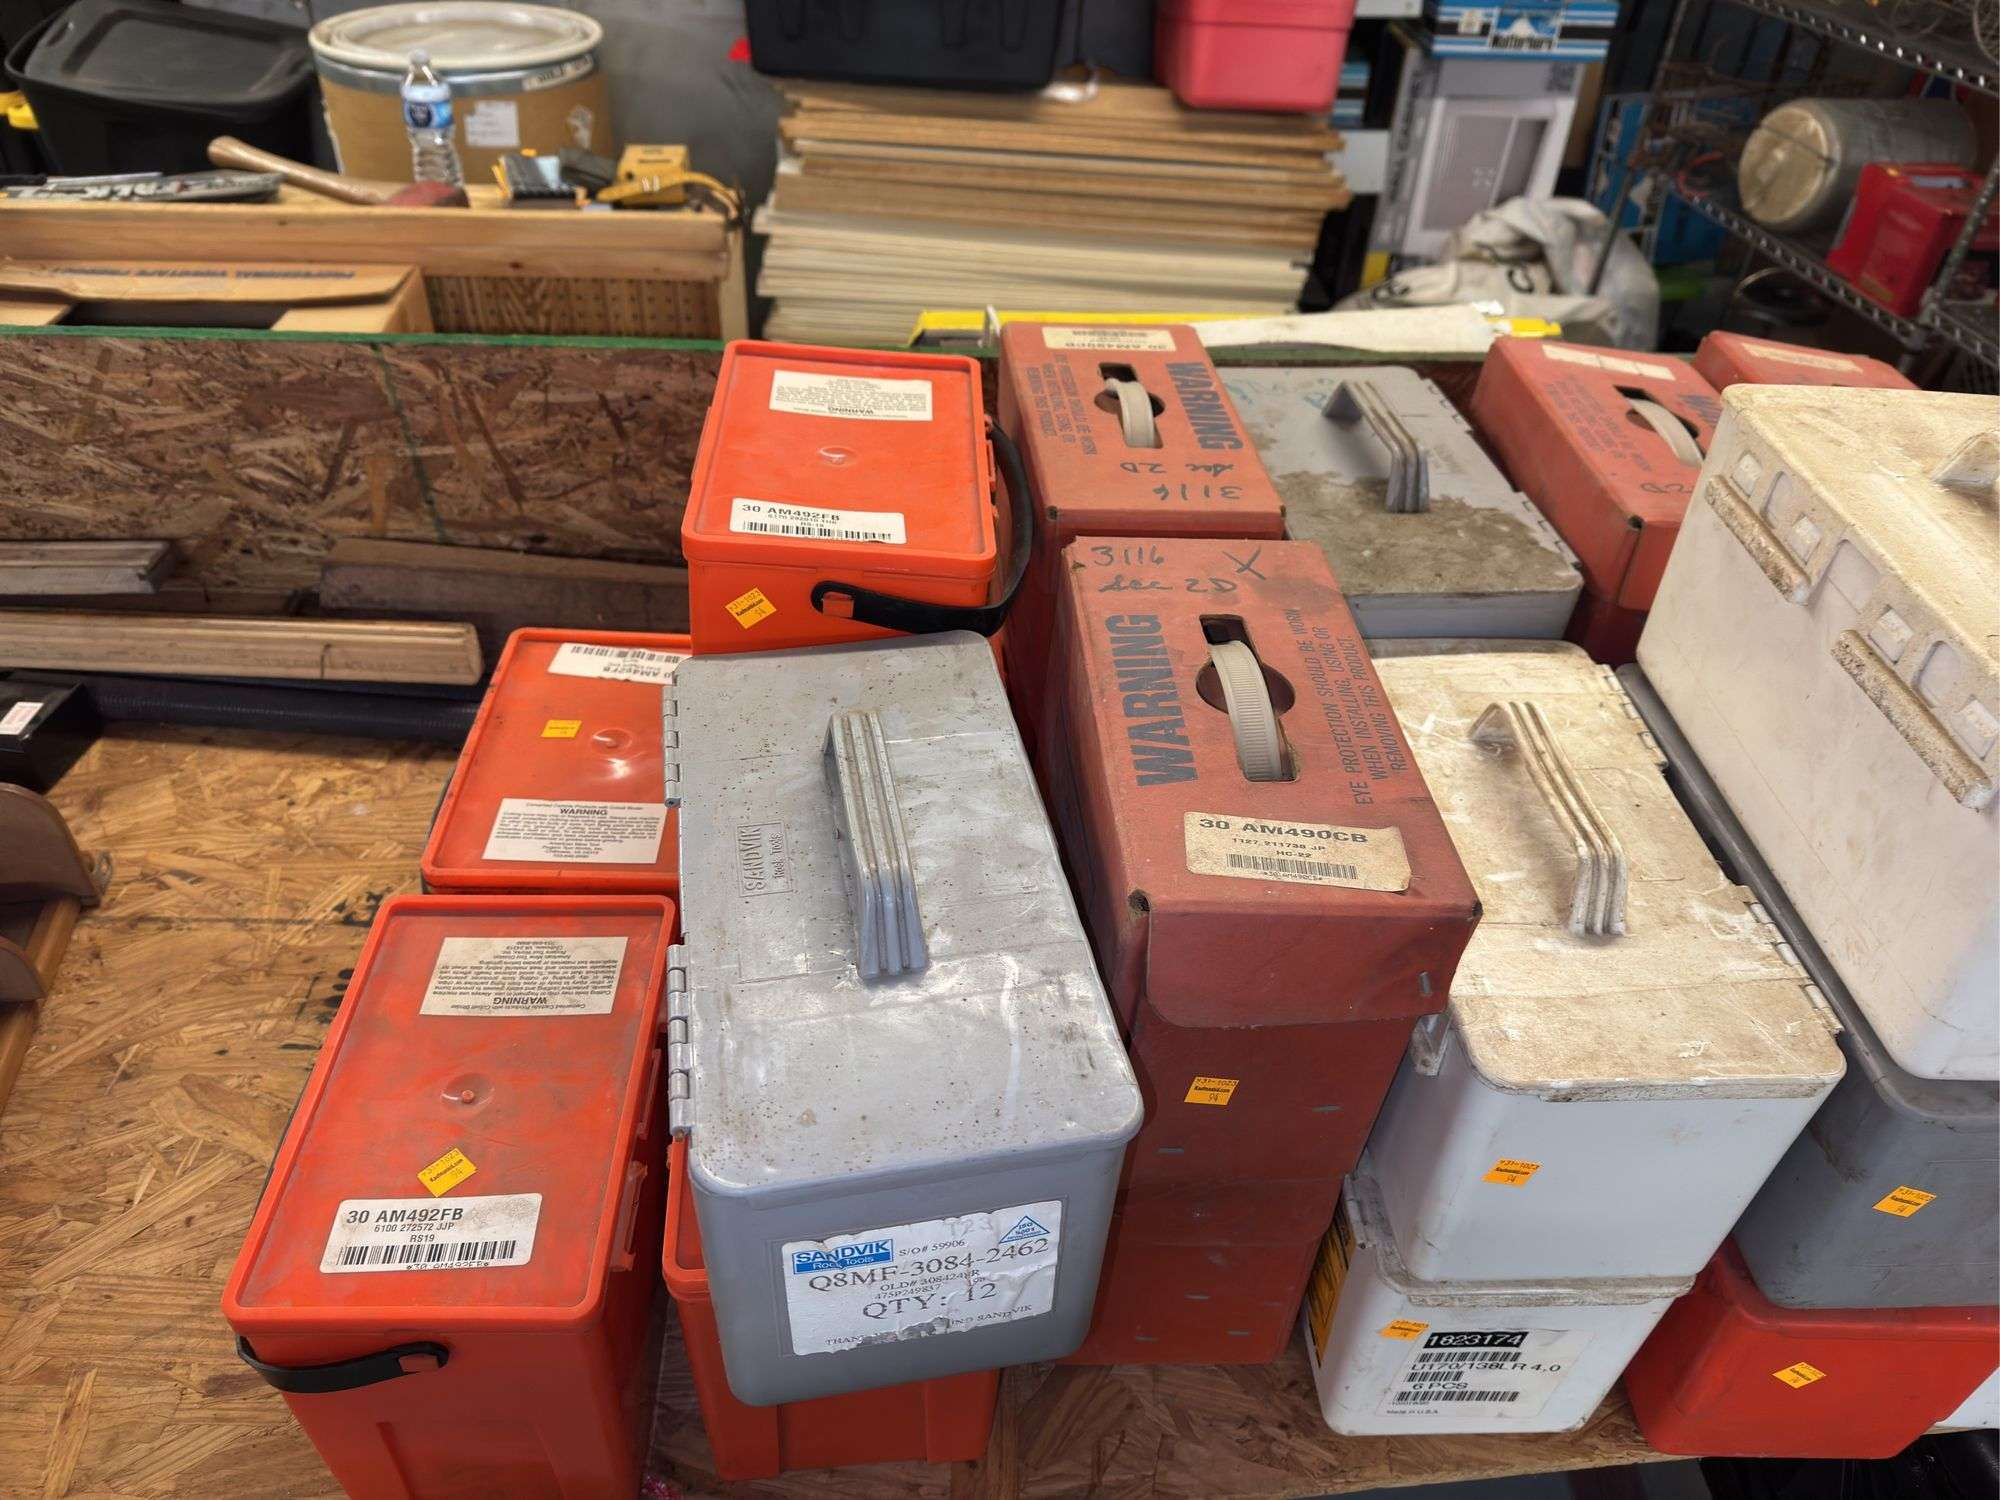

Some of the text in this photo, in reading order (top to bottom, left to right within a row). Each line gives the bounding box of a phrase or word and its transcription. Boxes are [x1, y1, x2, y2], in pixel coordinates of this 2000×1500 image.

[1166, 362, 1244, 449] WARNING
[742, 504, 841, 521] 30 AM492FB
[1091, 545, 1164, 566] 3116
[1312, 627, 1330, 640] OR
[1320, 643, 1345, 673] USING
[1105, 614, 1199, 787] WARNING
[1283, 608, 1374, 805] EYE PROTECTION SHOULD BE WORN
[1358, 686, 1380, 708] THIS
[1371, 713, 1408, 772] REMOVING
[1360, 745, 1388, 780] WHEN
[1200, 818, 1369, 843] 30 AM490CB
[738, 827, 766, 891] SANDVIK
[1276, 850, 1312, 858] HC-22
[346, 1207, 464, 1224] 30 AM492FB
[374, 1222, 455, 1232] 6100 272572 JJP
[409, 1234, 435, 1242] RS19
[796, 1239, 966, 1263] SANDVIK S/O# 59906
[846, 1256, 875, 1267] Tools
[808, 1238, 1049, 1292] Q8MF-3084-2462
[880, 1279, 919, 1292] OLD#
[862, 1282, 998, 1320] QTY: 12
[976, 1304, 1033, 1322] SANDVIK
[1428, 1333, 1523, 1348] 1823174
[1412, 1382, 1469, 1390] 6 PCS
